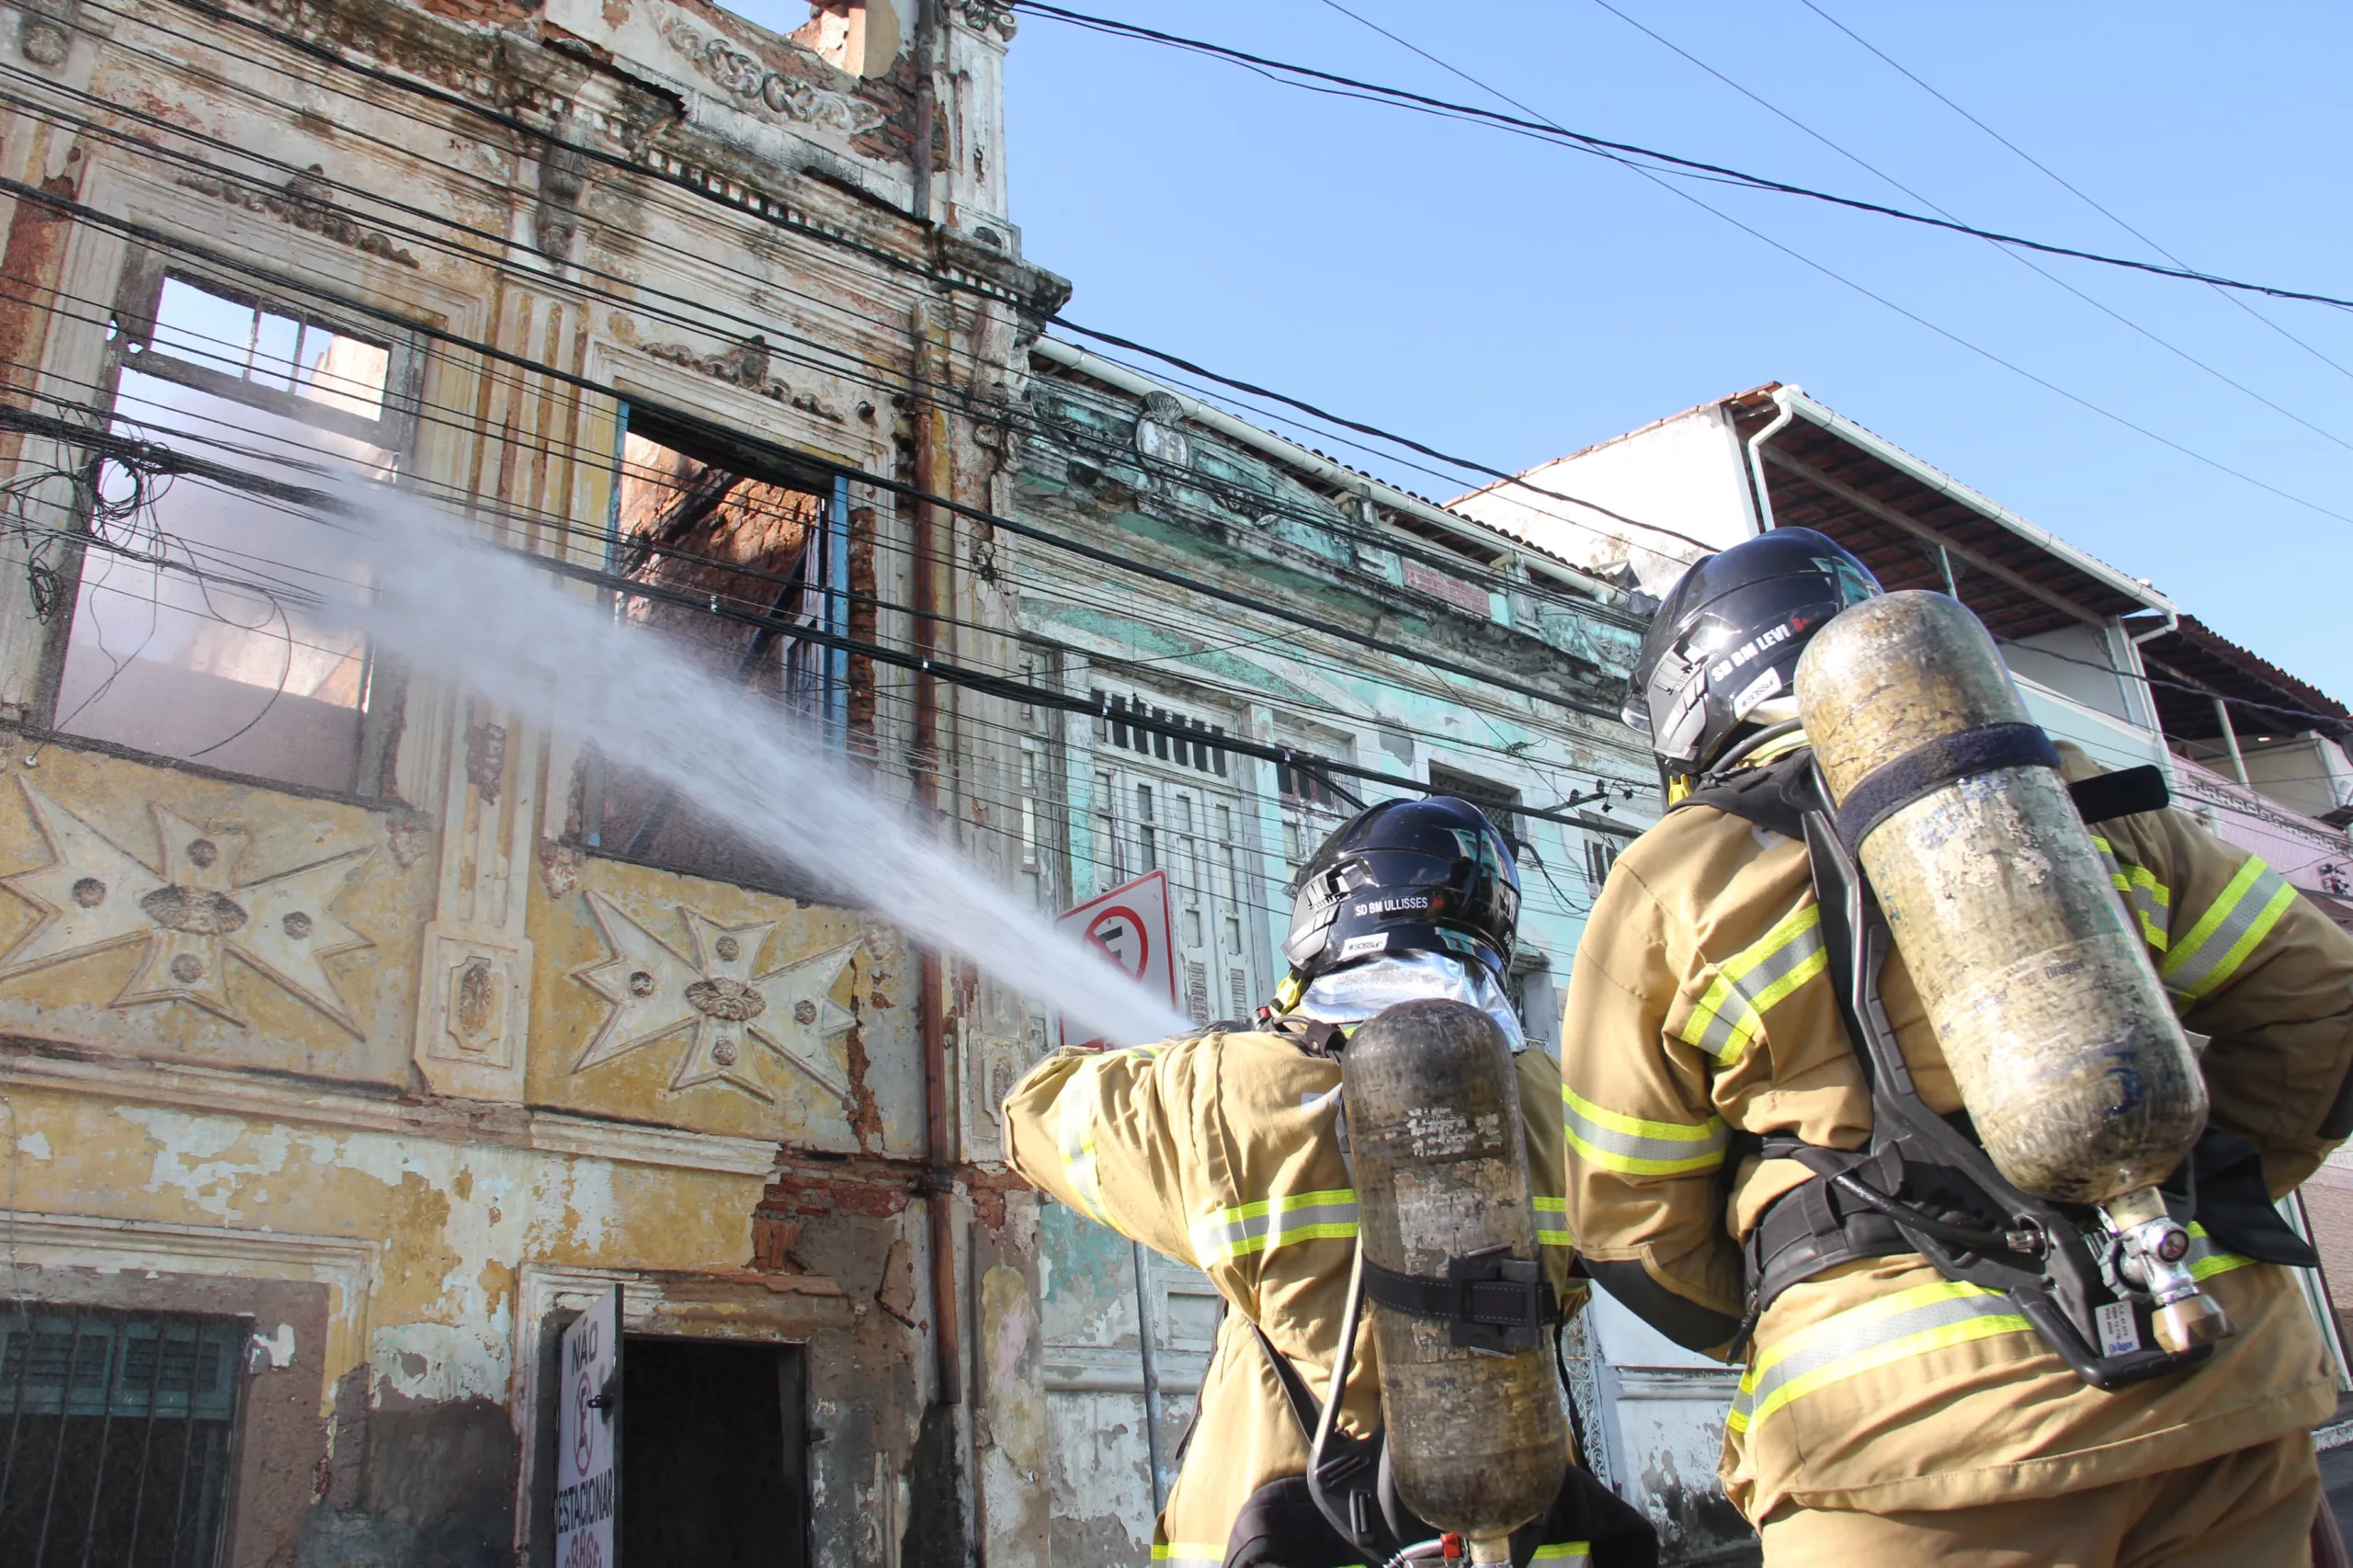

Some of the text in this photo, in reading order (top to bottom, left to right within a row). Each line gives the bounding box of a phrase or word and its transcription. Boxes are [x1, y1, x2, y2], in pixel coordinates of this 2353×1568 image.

[1711, 659, 1733, 682] SD
[1730, 642, 1759, 667] BM
[1756, 623, 1791, 651] LEVI
[1355, 903, 1368, 917] SD
[1369, 900, 1383, 915] BM
[1384, 896, 1428, 912] ULLISSES
[2043, 958, 2086, 980] Dräger
[2109, 1341, 2133, 1353] Dräger
[557, 1468, 613, 1534] ESTACIONAR
